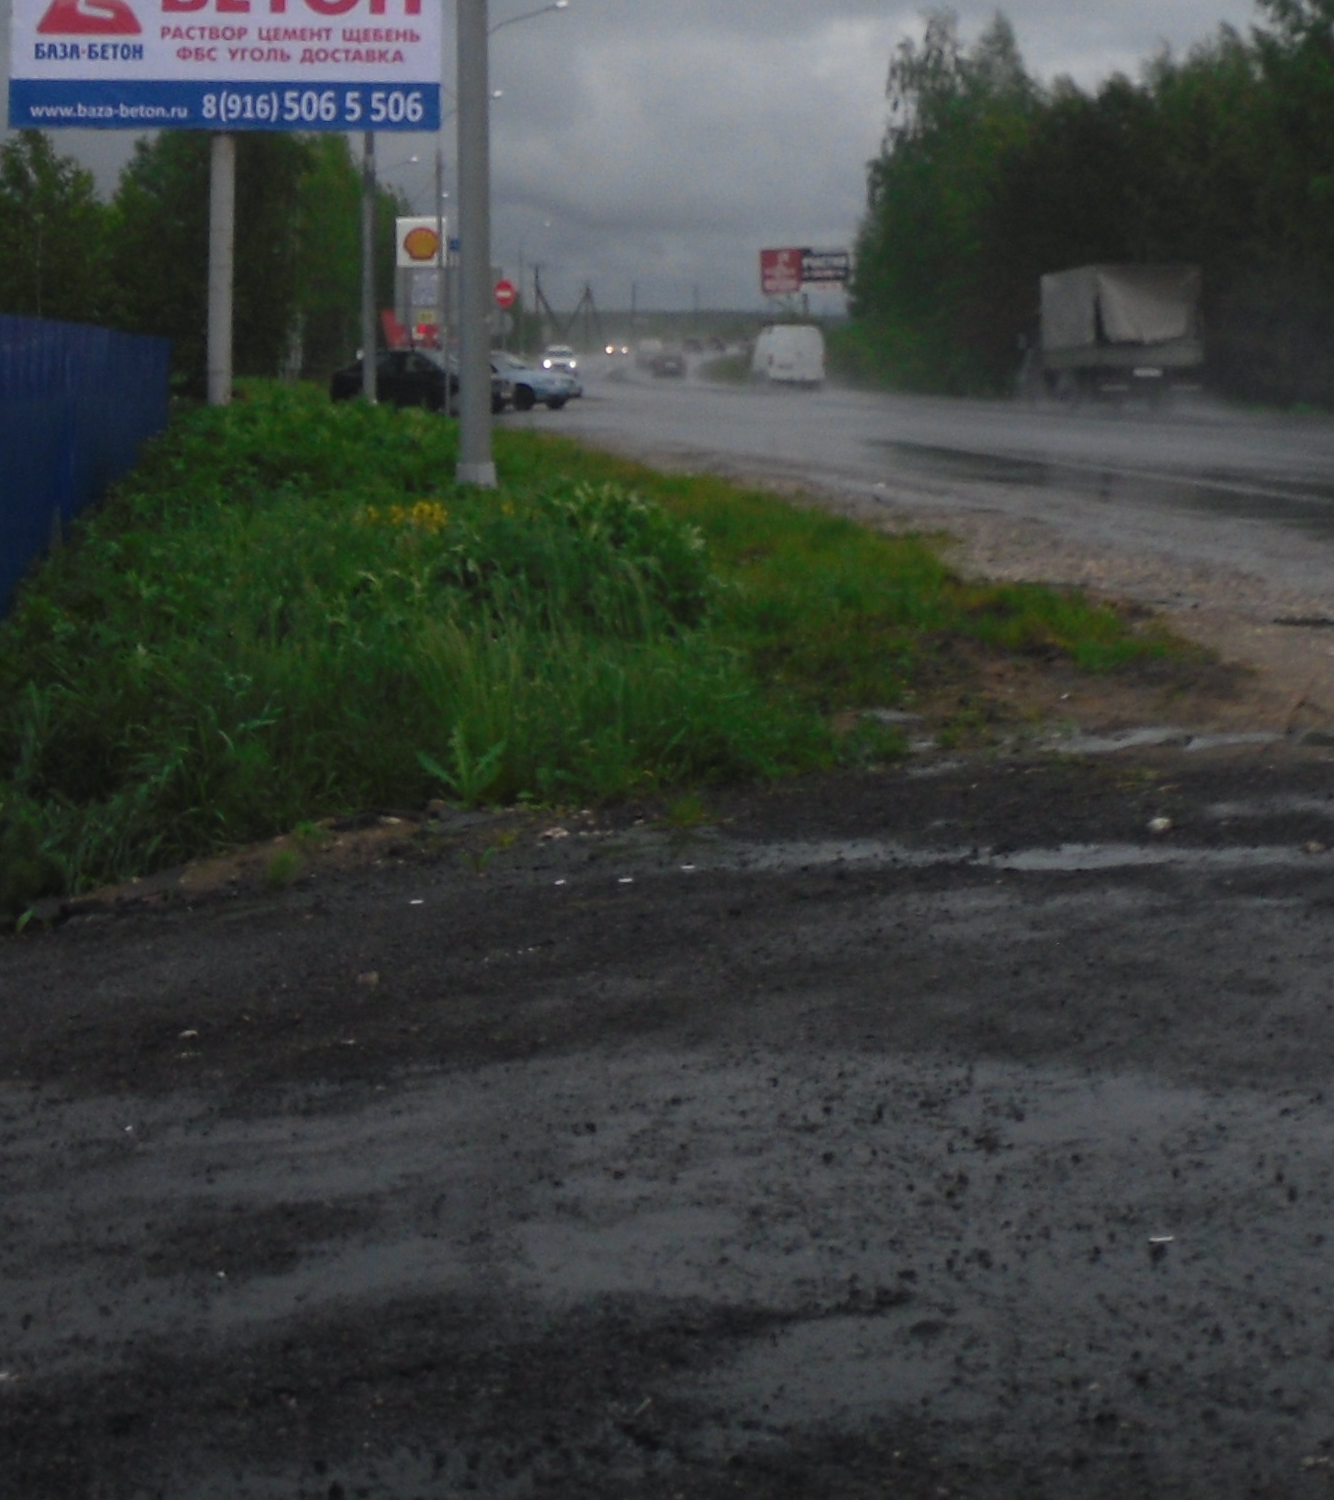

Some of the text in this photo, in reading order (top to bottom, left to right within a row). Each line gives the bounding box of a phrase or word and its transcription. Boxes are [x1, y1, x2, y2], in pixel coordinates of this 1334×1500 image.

[160, 27, 421, 44] РАСТВОР ЦЕМЕНТ ЩЕБЕНЬ
[176, 46, 405, 65] ФБС УГОЛЬ ДОСТАВКА
[30, 102, 188, 119] www.baza-beton.ru
[283, 91, 336, 122] 506
[369, 93, 423, 123] 506
